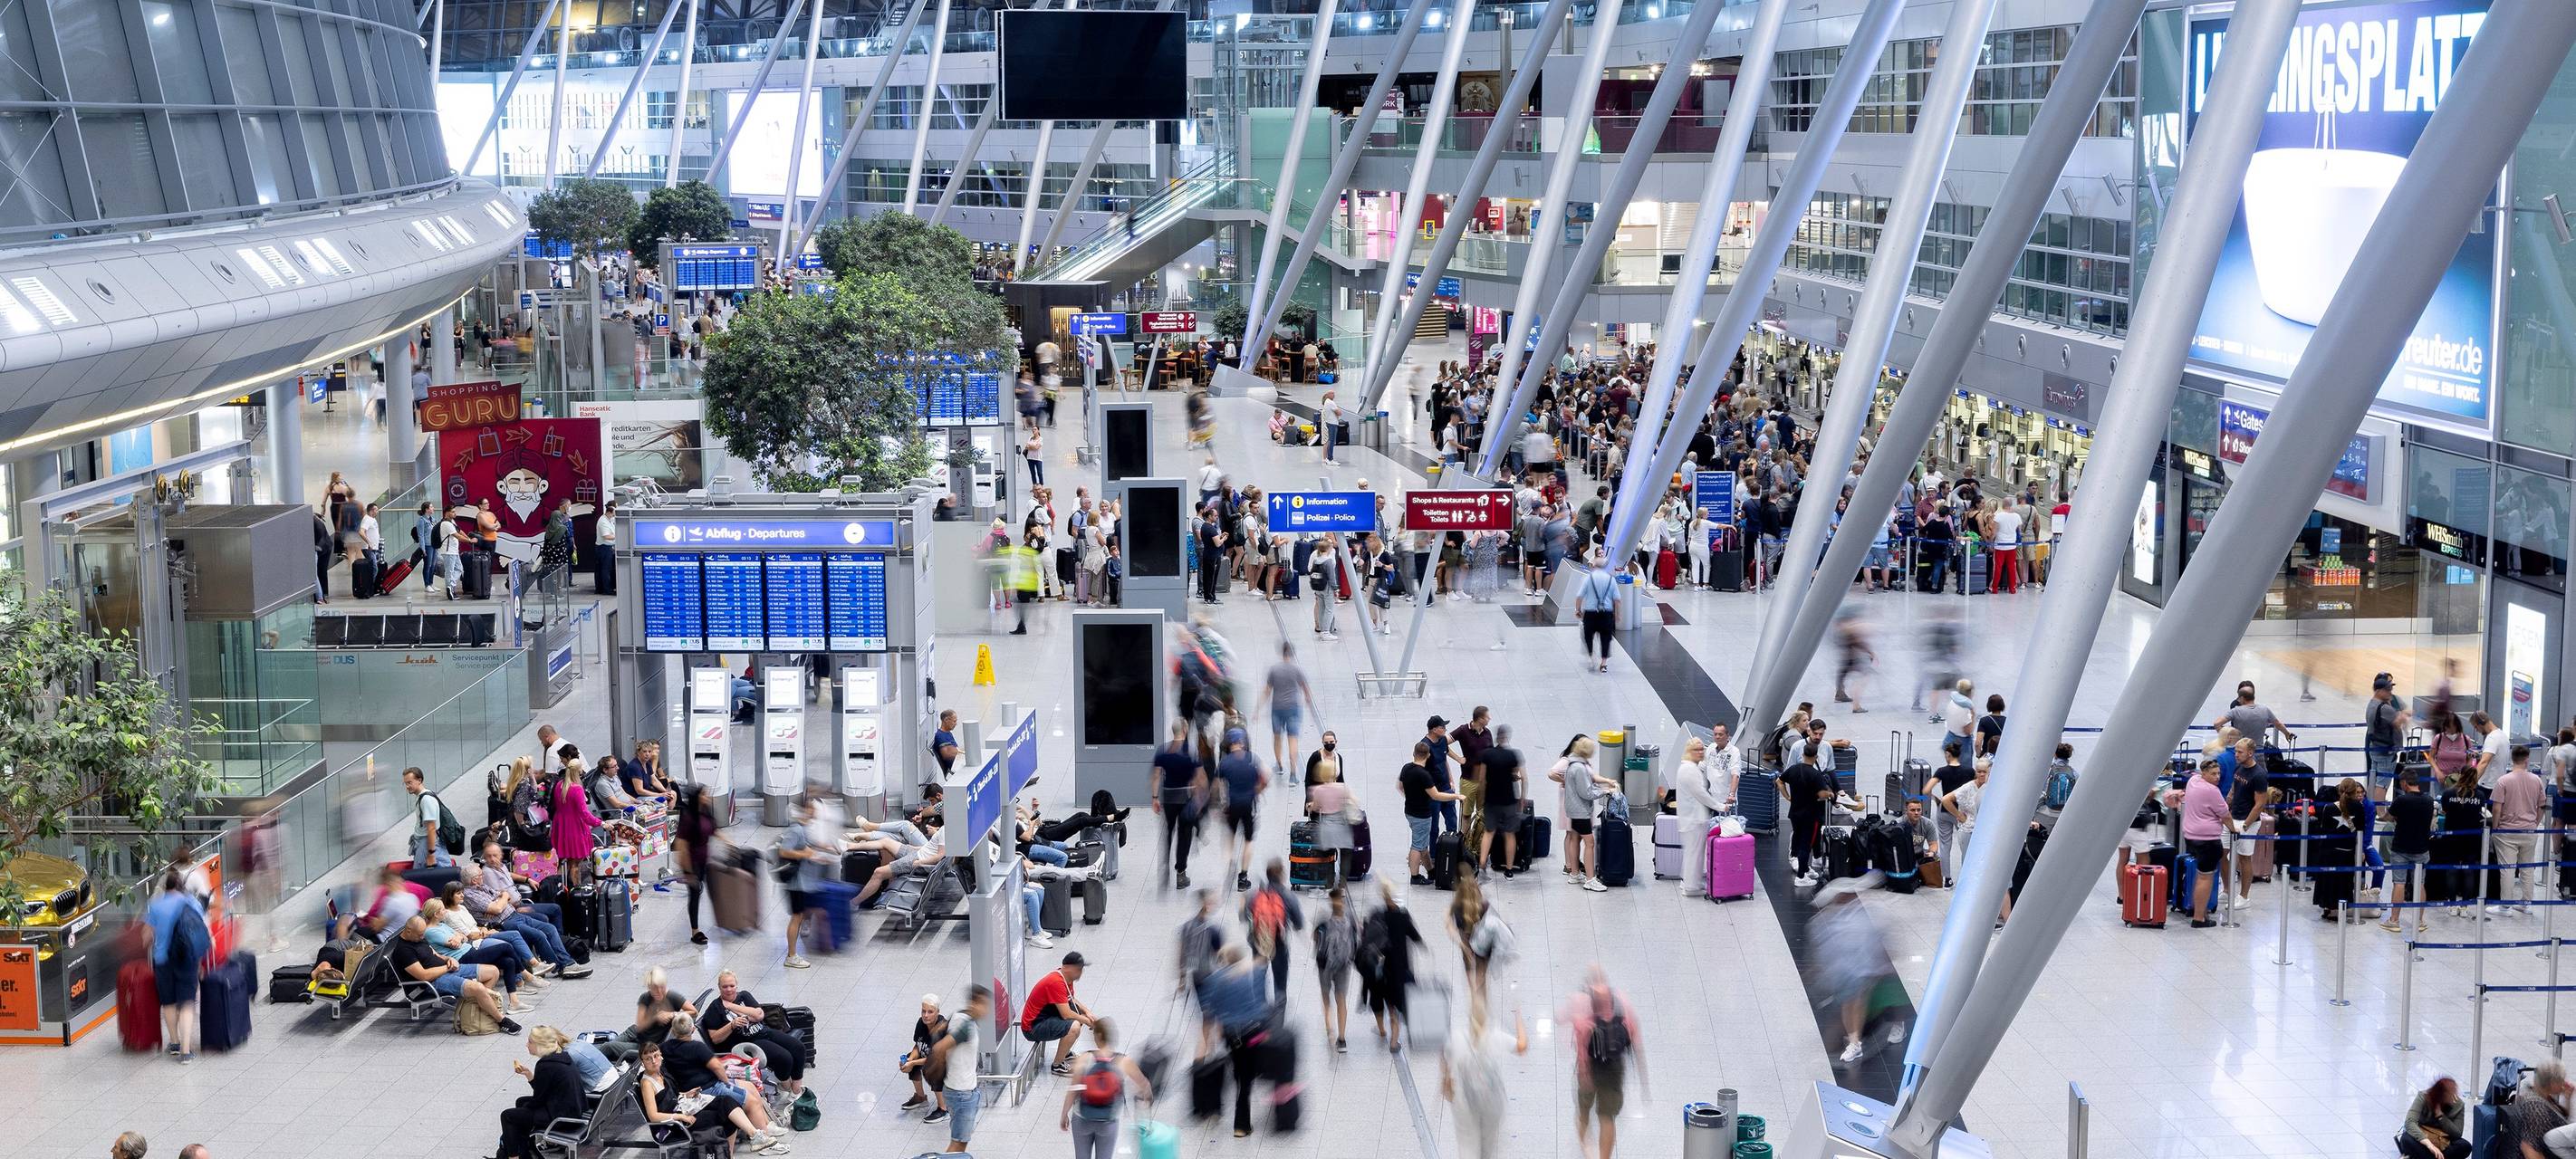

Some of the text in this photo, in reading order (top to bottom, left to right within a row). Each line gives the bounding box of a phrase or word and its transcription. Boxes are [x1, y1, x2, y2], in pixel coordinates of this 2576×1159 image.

[2195, 13, 2487, 113] LINGSPLAT
[659, 315, 666, 324] P
[2403, 333, 2483, 375] reuter.de
[432, 384, 497, 398] SHOPPING
[424, 395, 518, 429] GURU
[2240, 410, 2264, 432] Gates
[611, 425, 651, 433] reditkarten
[1306, 497, 1348, 506] Information
[1412, 497, 1431, 505] Shops
[1438, 497, 1475, 505] Restaurants
[1307, 513, 1356, 522] Polizei Police
[706, 527, 806, 541] Abflug Departures
[2427, 522, 2463, 548] WHSmith
[2441, 542, 2463, 558] EXPRESS
[333, 655, 355, 665] DUS
[452, 654, 499, 663] Servicepunkt
[482, 662, 499, 670] point
[3, 952, 31, 963] SIXT
[0, 978, 18, 992] er.
